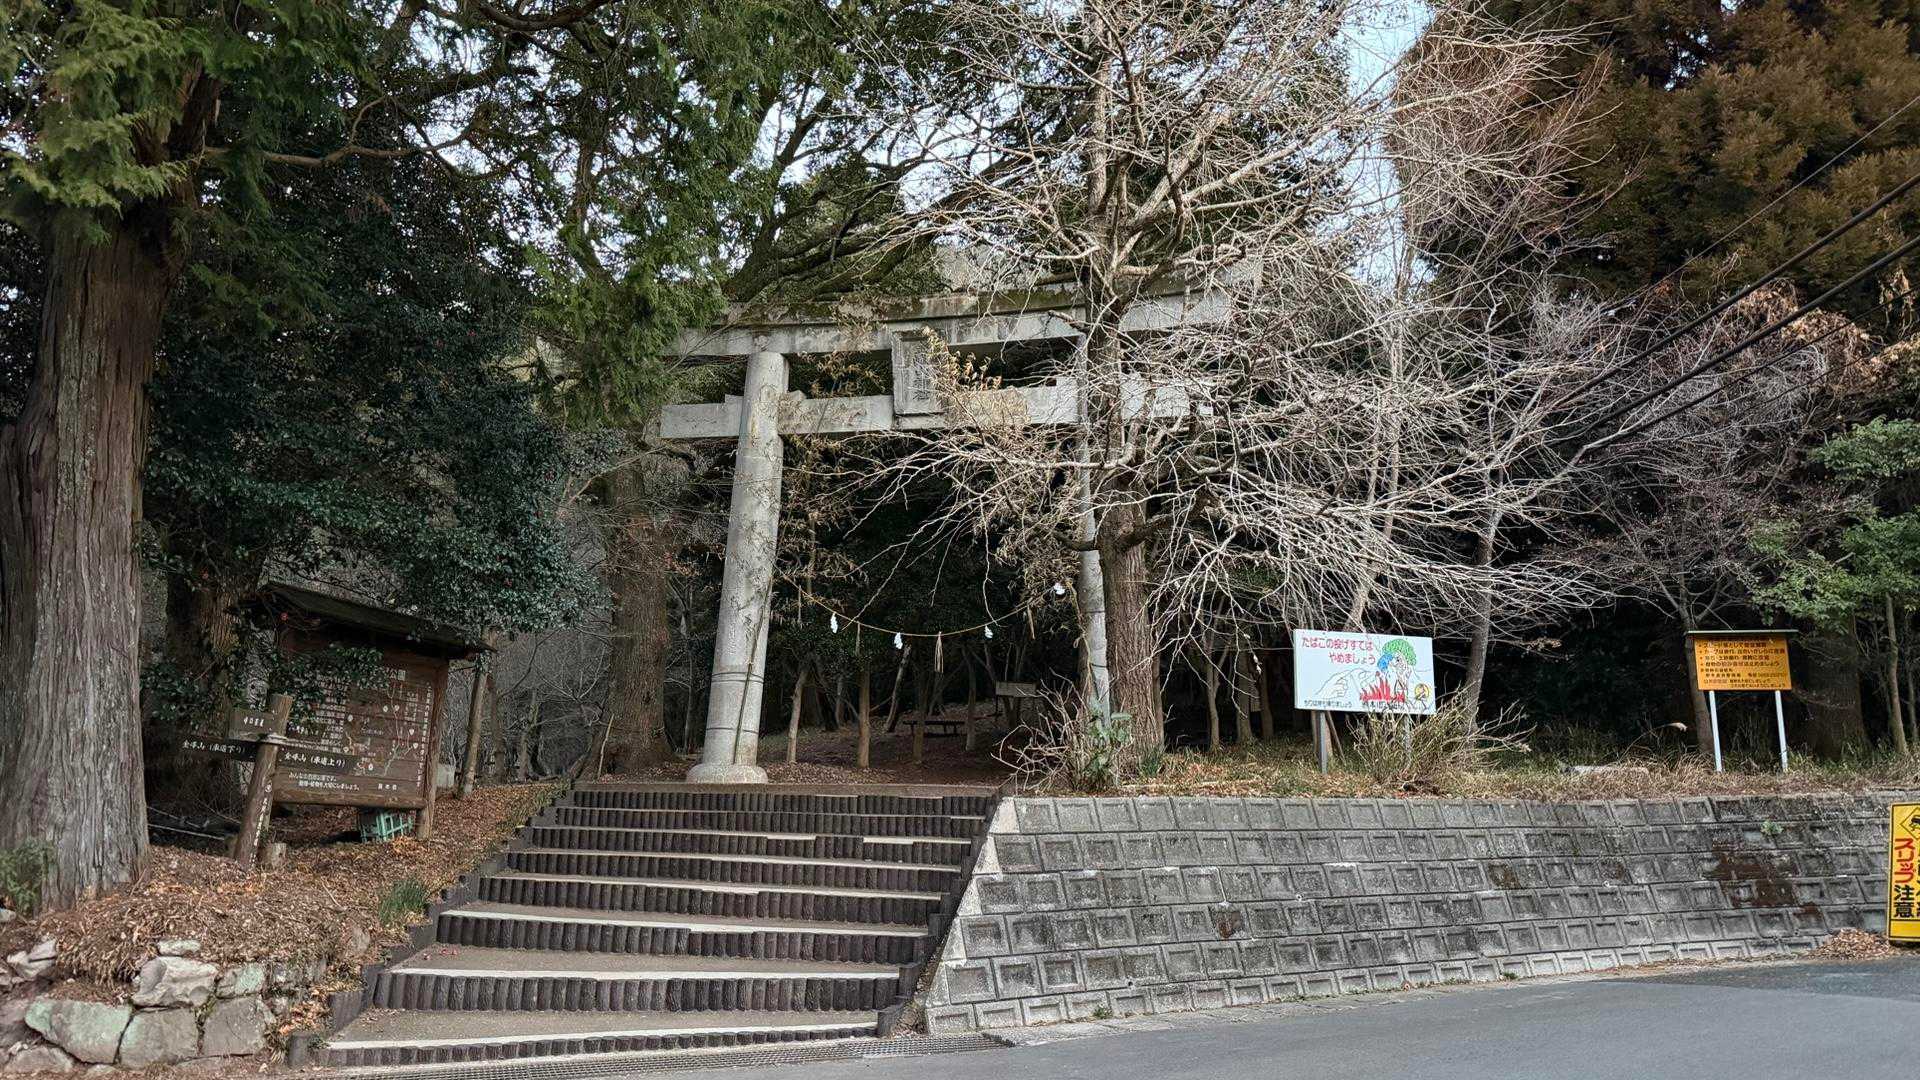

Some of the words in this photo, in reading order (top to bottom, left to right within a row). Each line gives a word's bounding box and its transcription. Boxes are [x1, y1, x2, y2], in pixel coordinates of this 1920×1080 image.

[1302, 637, 1373, 650] たばこの投げすては
[1329, 652, 1376, 665] やめましょう
[1894, 837, 1916, 919] スリップ注意
